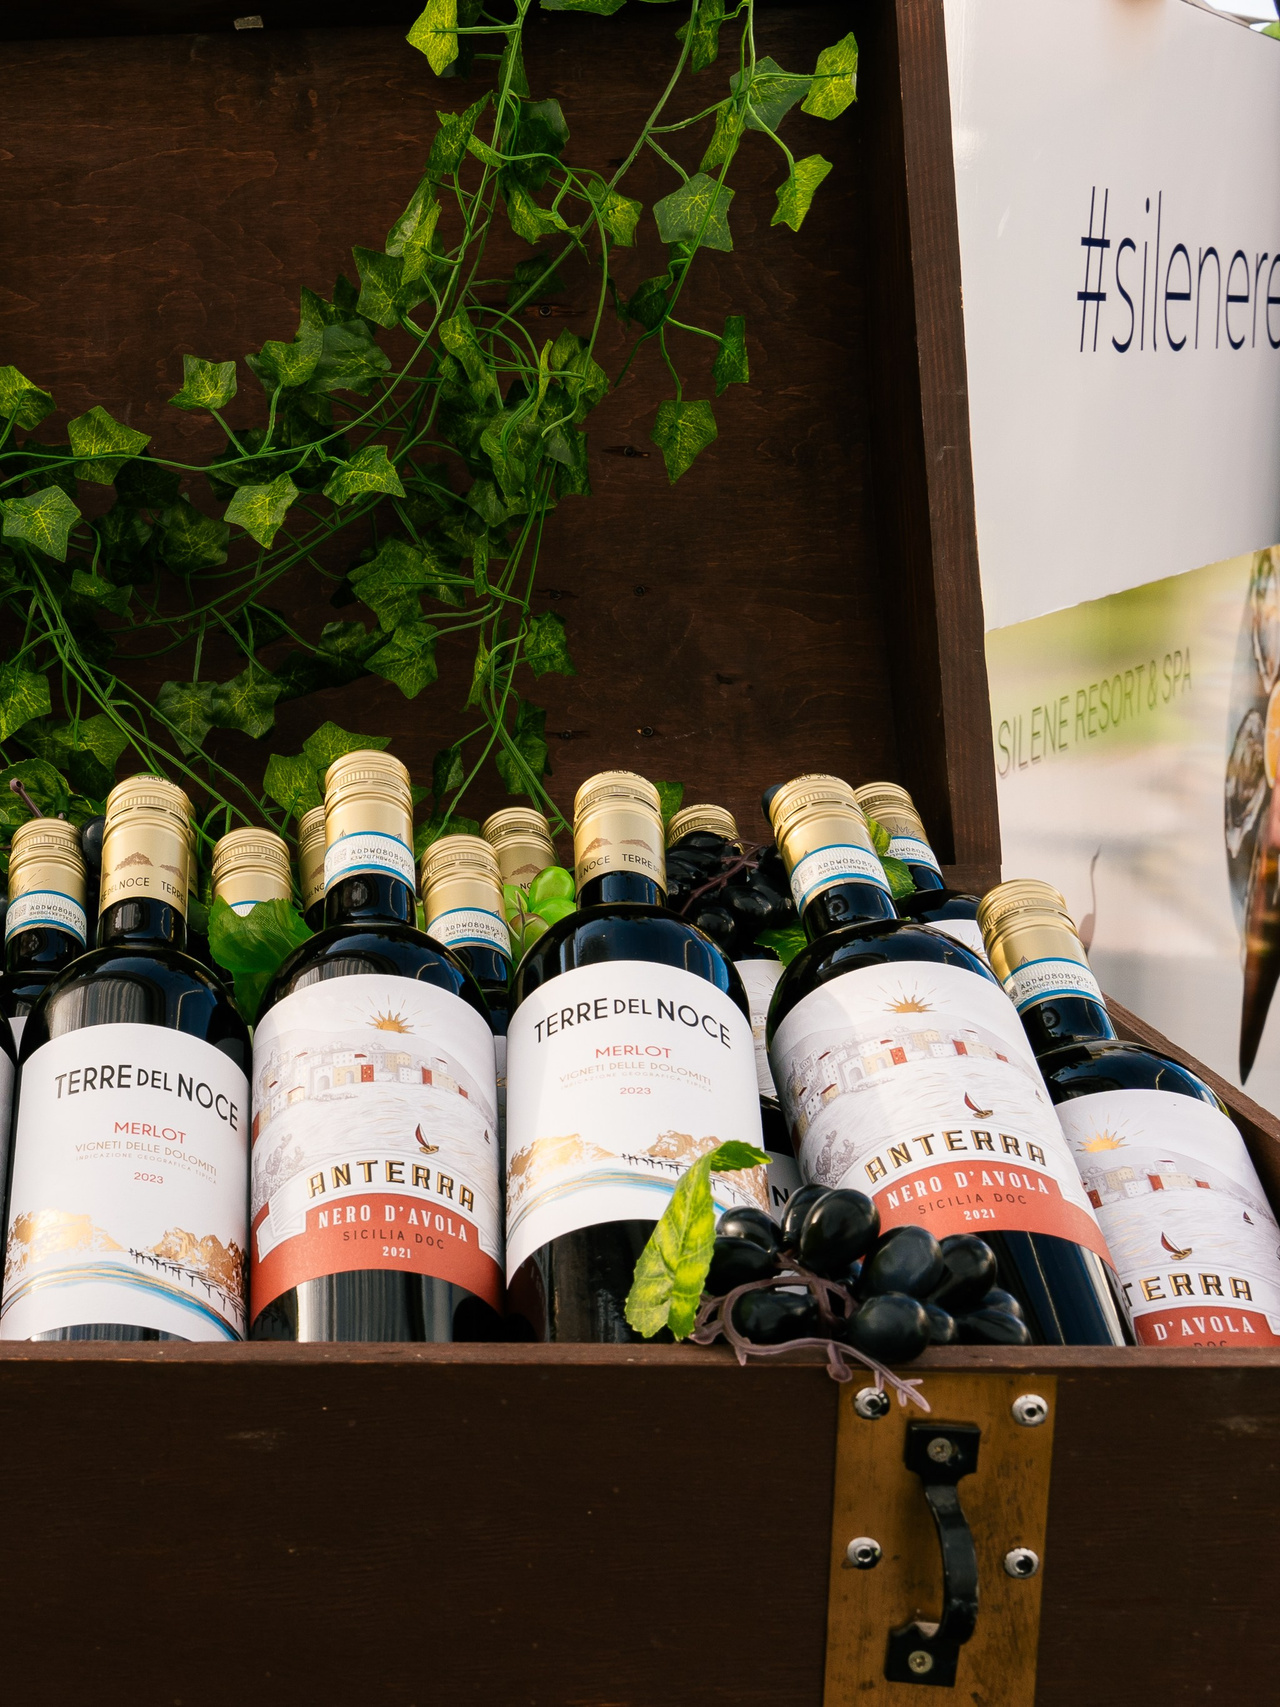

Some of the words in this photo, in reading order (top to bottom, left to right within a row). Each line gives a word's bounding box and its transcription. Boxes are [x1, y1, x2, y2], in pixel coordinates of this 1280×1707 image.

[997, 695, 1069, 780] SILENE
[1074, 664, 1144, 741] RESORT
[1147, 660, 1158, 710] &
[1162, 646, 1192, 703] SPA
[583, 855, 611, 876] NOCE
[621, 853, 653, 870] TERRE
[118, 877, 150, 890] NOCE
[534, 997, 608, 1044] TERRE
[613, 998, 652, 1015] DEL
[657, 998, 732, 1049] NOCE
[595, 1044, 672, 1059] MERLOT
[559, 1064, 604, 1083] VIGNETI
[609, 1061, 645, 1070] DELLE
[650, 1061, 711, 1086] DOLOMITI
[54, 1064, 132, 1099] TERRE
[137, 1068, 173, 1092] DEL
[177, 1073, 238, 1131] NOCE
[619, 1087, 651, 1095] 2023
[114, 1121, 186, 1144] MERLOT
[75, 1140, 121, 1153] VIGNETI
[126, 1141, 160, 1154] DELLE
[165, 1147, 217, 1177] DOLOMITI
[864, 1129, 1047, 1184] ANTERRA
[134, 1172, 164, 1184] 2023
[306, 1160, 475, 1213] ANTERRA
[886, 1176, 942, 1210] NERO
[954, 1170, 1050, 1195] D'AVOLA
[918, 1193, 984, 1215] SICILIA
[994, 1192, 1027, 1205] DOC
[963, 1208, 996, 1221] 2021
[319, 1205, 370, 1229] NERO
[385, 1205, 468, 1242] D'AVOLA
[343, 1229, 405, 1241] SICILIA
[415, 1233, 444, 1249] DOC
[382, 1246, 411, 1258] 2021
[1153, 1315, 1255, 1341] D'AVOLA
